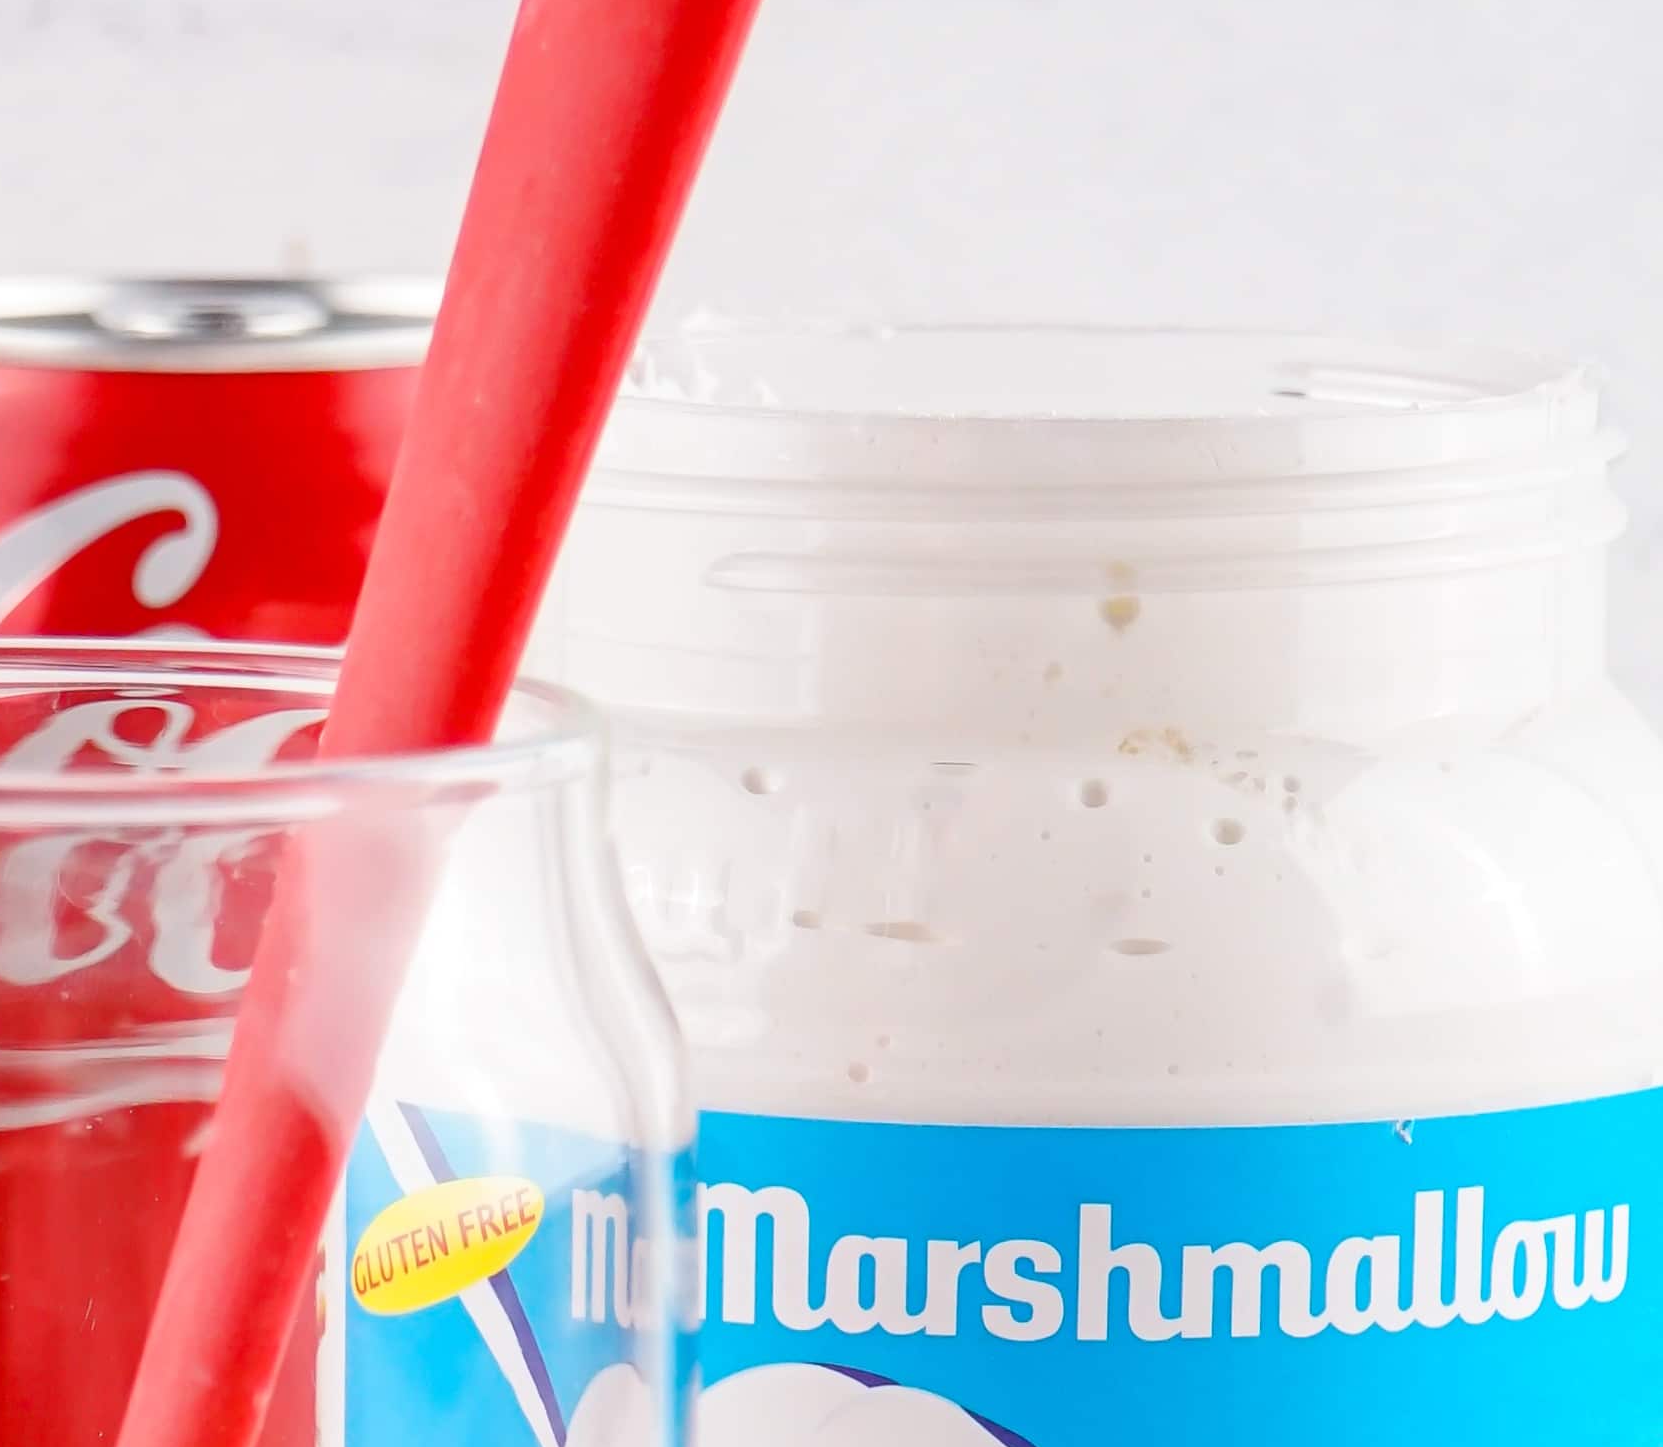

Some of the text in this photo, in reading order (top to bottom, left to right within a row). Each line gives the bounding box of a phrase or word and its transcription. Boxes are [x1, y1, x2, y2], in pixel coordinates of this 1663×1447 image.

[352, 1186, 536, 1296] GLUTEN FREE
[695, 1182, 1630, 1342] Marshmallow
